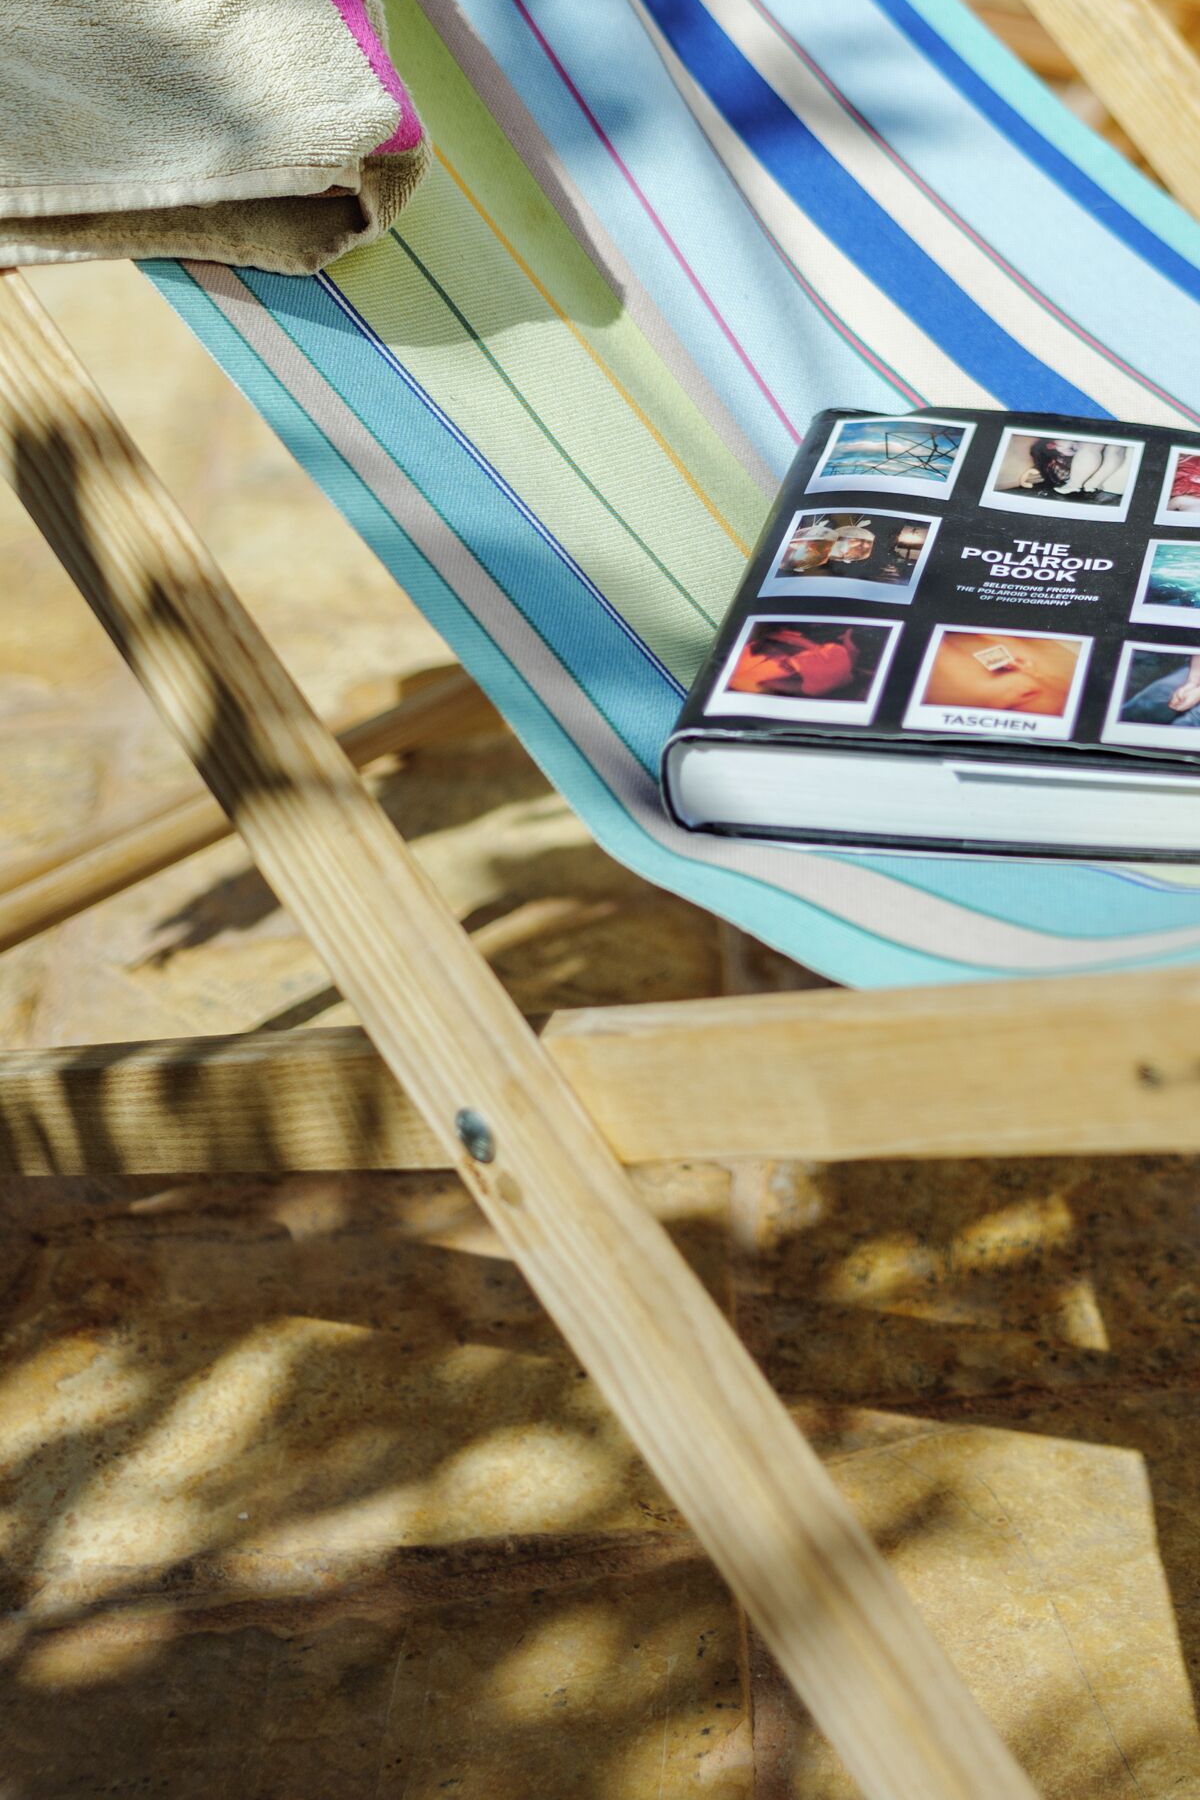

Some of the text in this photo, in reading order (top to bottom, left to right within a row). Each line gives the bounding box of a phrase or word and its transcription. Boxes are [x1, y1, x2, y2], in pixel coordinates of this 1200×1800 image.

[1013, 539, 1071, 556] THE
[960, 547, 1114, 571] POLAROID
[989, 564, 1077, 582] BOOK
[956, 584, 1100, 602] THE POLAROID COLLECTIONS
[982, 581, 1076, 594] SELECTIONS FROM
[995, 596, 1072, 607] PHOTOGRAPHY
[943, 714, 1037, 731] TASCHEN
